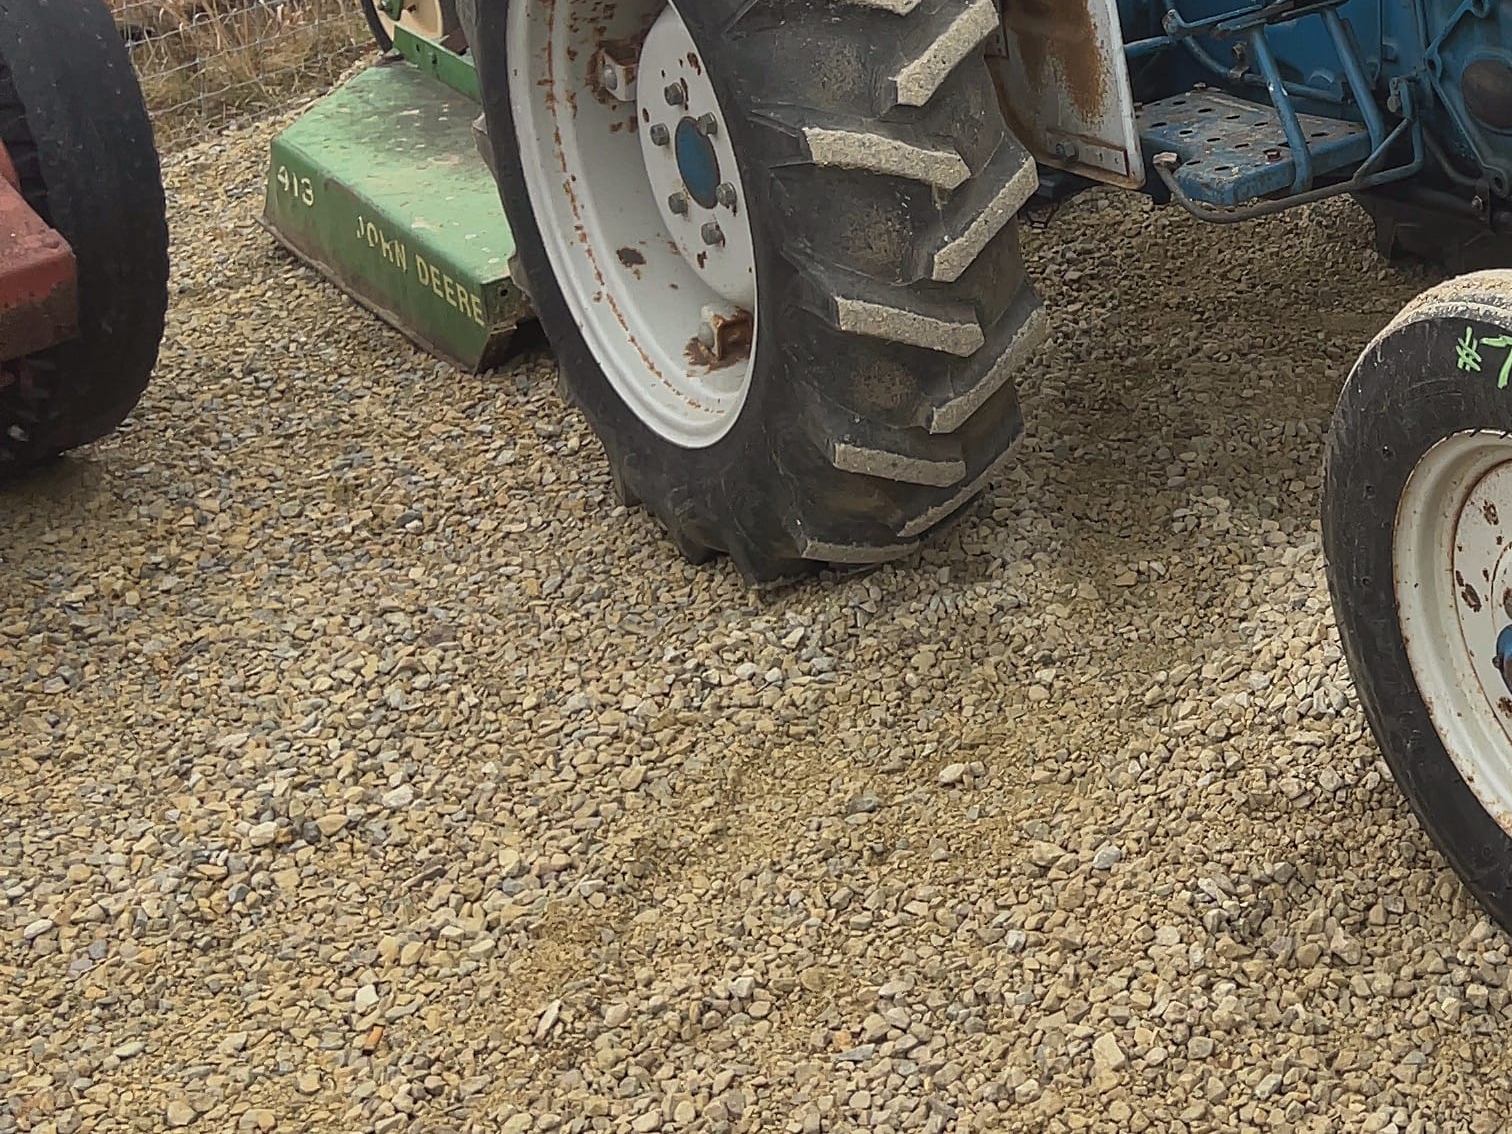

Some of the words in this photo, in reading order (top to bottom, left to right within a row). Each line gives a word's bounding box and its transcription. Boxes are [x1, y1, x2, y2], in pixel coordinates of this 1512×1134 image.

[276, 165, 315, 207] 413
[356, 215, 408, 274] JOHN
[415, 253, 486, 328] DEERE
